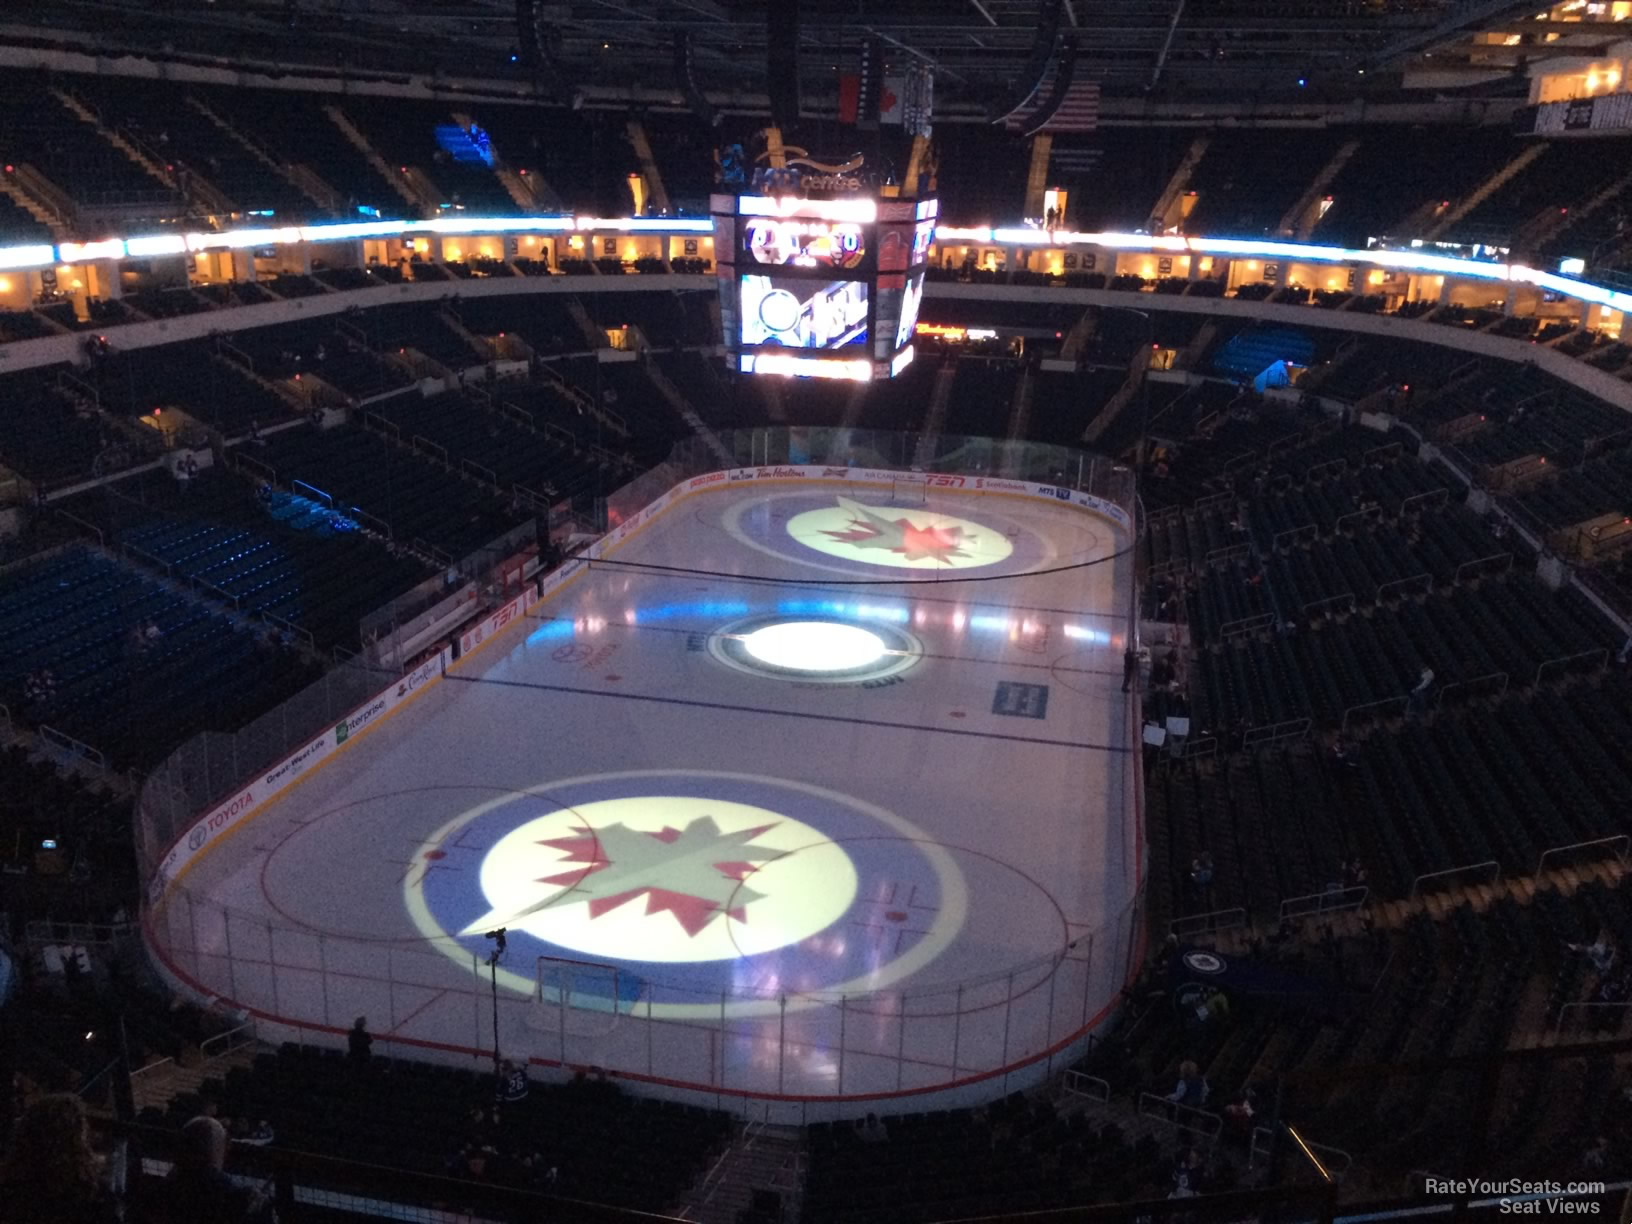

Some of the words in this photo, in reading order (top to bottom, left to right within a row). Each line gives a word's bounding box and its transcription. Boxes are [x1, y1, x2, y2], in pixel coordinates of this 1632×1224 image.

[801, 175, 862, 192] centre
[756, 467, 772, 479] Tim
[925, 474, 965, 488] TSN
[1038, 486, 1055, 497] MTS
[492, 601, 517, 630] TSN
[208, 791, 254, 832] TOYOTA
